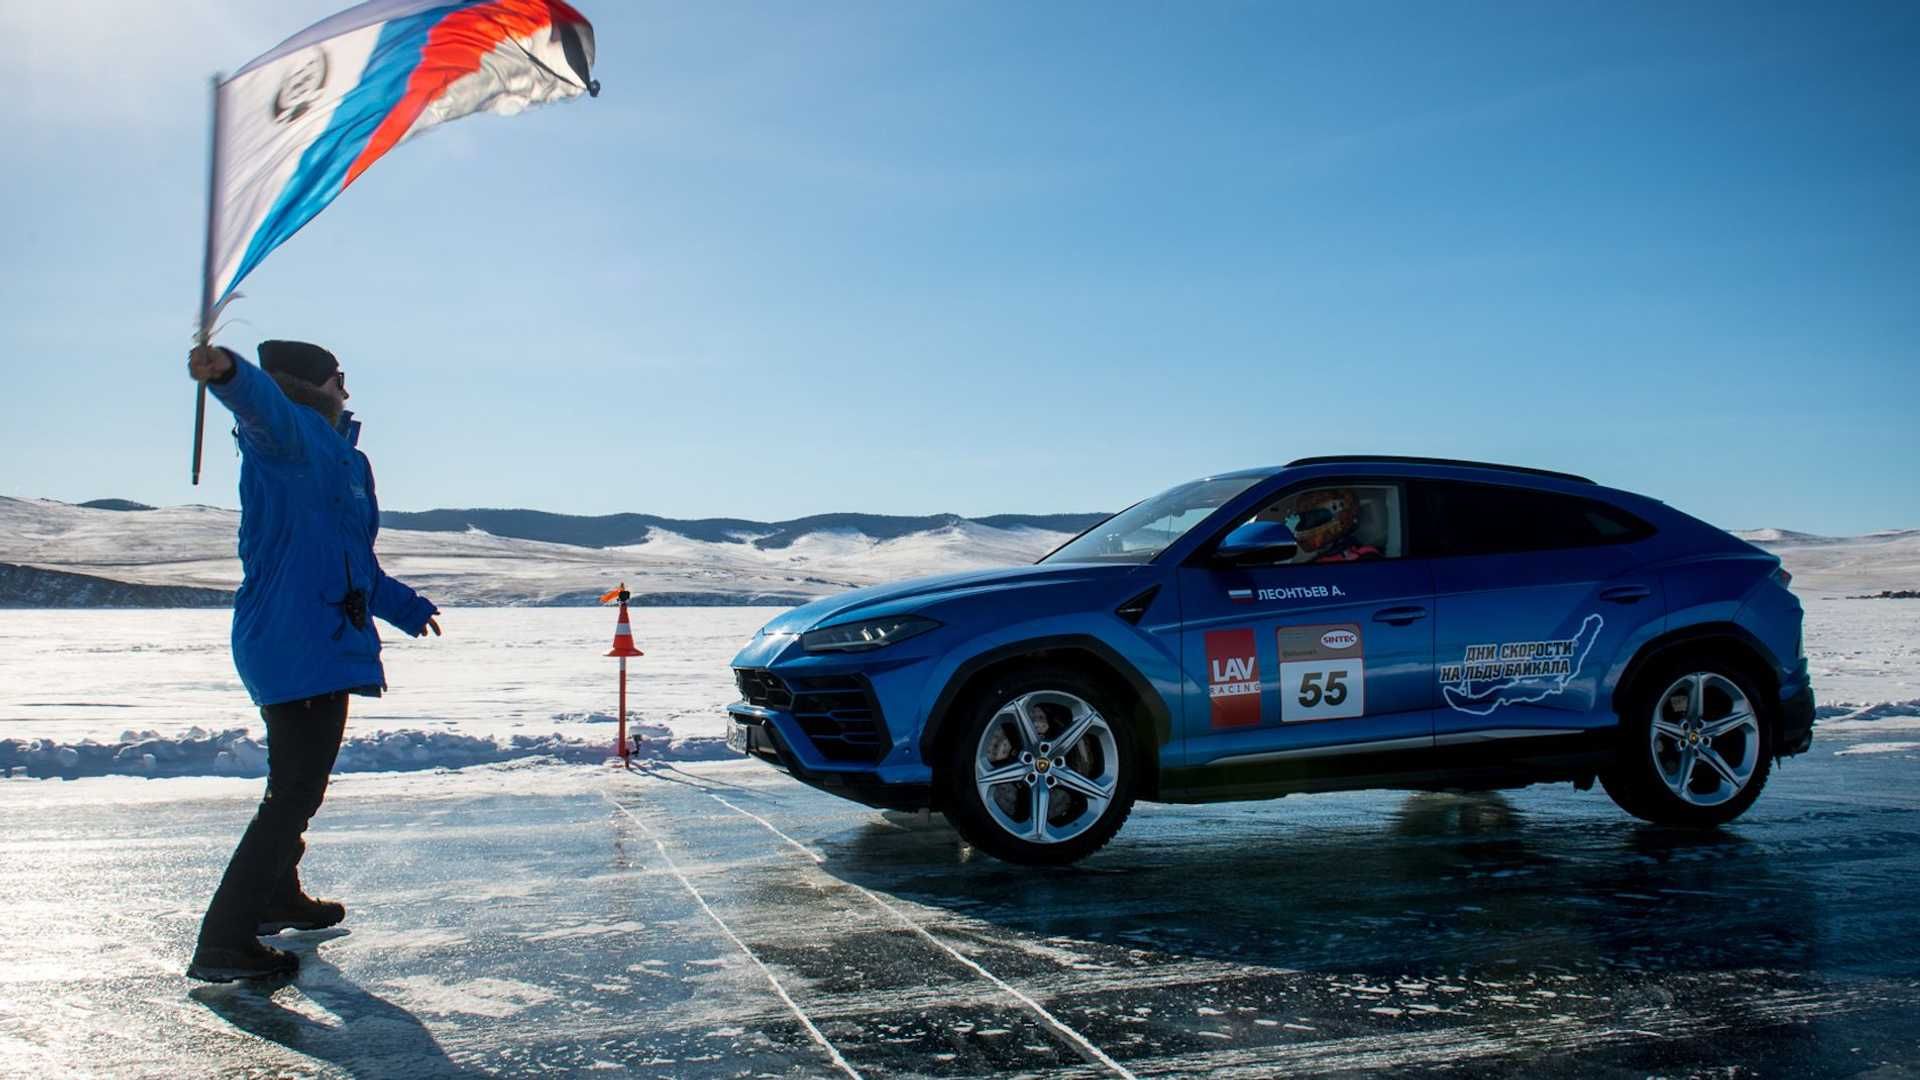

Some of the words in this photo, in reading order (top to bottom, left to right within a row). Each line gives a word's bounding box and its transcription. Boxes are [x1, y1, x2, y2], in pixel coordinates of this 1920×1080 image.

[1258, 586, 1328, 600] ЛЕОНТЬЕВ
[1332, 585, 1346, 597] А.
[1323, 634, 1356, 644] SINTEC
[1466, 645, 1497, 663] ДНИ
[1501, 641, 1573, 660] СКОРОСТИ
[1213, 656, 1255, 681] LAV
[1441, 667, 1461, 682] НА
[1464, 663, 1502, 681] ЛЬДУ
[1503, 660, 1570, 678] БАЙКАЛА
[1209, 683, 1260, 694] RACING
[1298, 671, 1347, 708] 55
